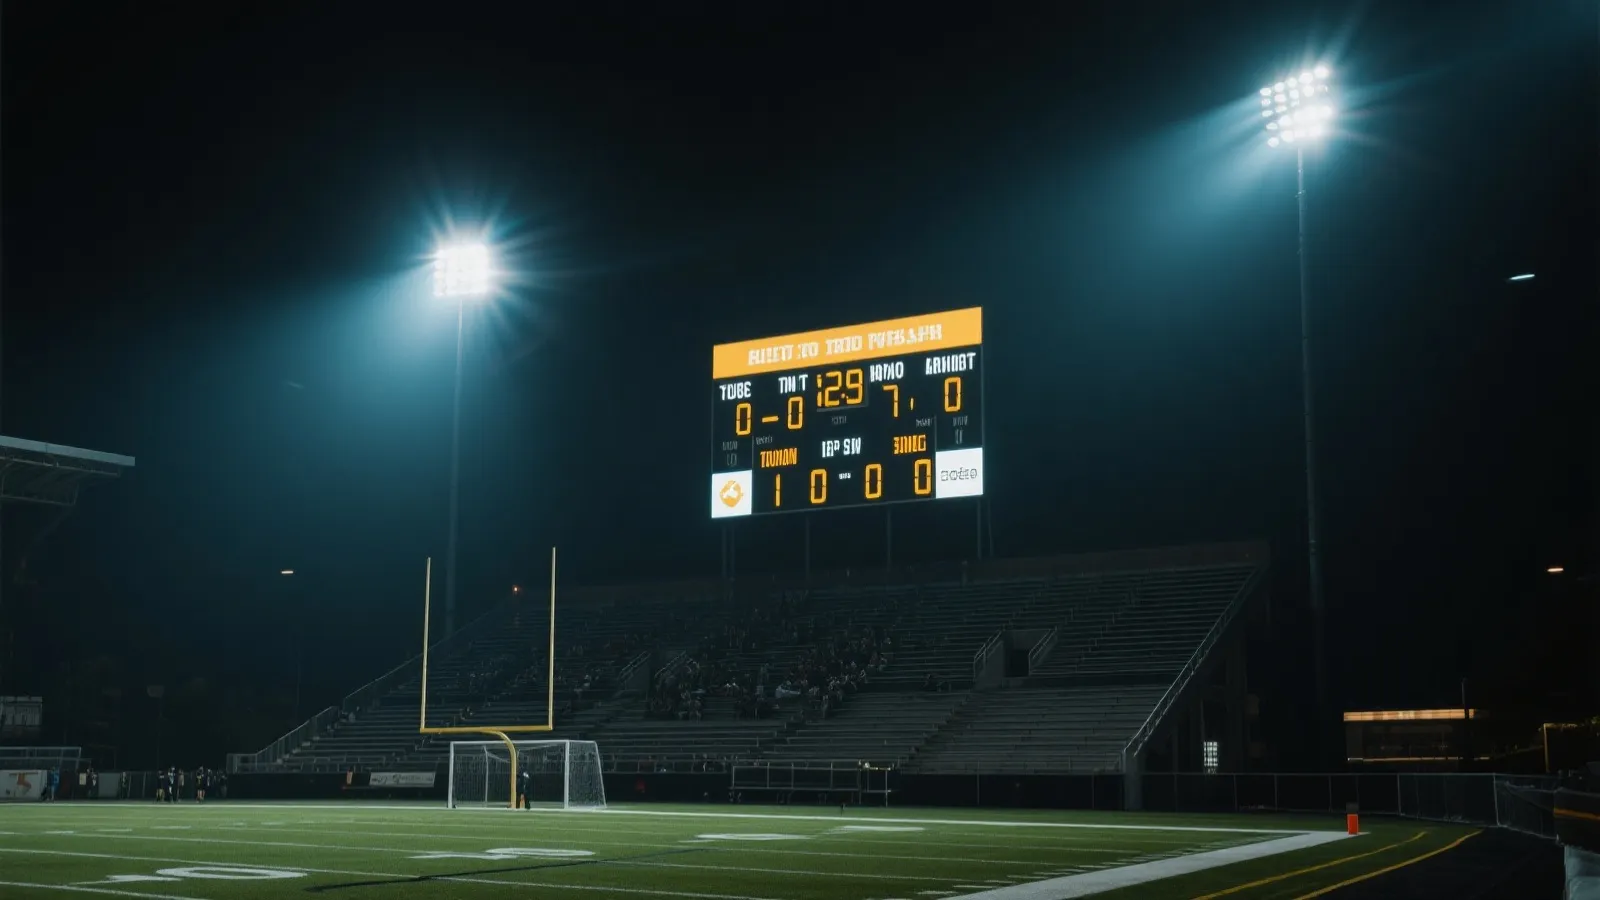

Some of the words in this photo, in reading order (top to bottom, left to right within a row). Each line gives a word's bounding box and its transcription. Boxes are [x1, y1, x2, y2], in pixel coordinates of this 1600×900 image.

[944, 376, 962, 412] 0
[735, 402, 752, 436] 0
[787, 396, 804, 429] 0
[810, 468, 828, 504] 0
[865, 463, 882, 499] 0
[914, 459, 932, 494] 0
